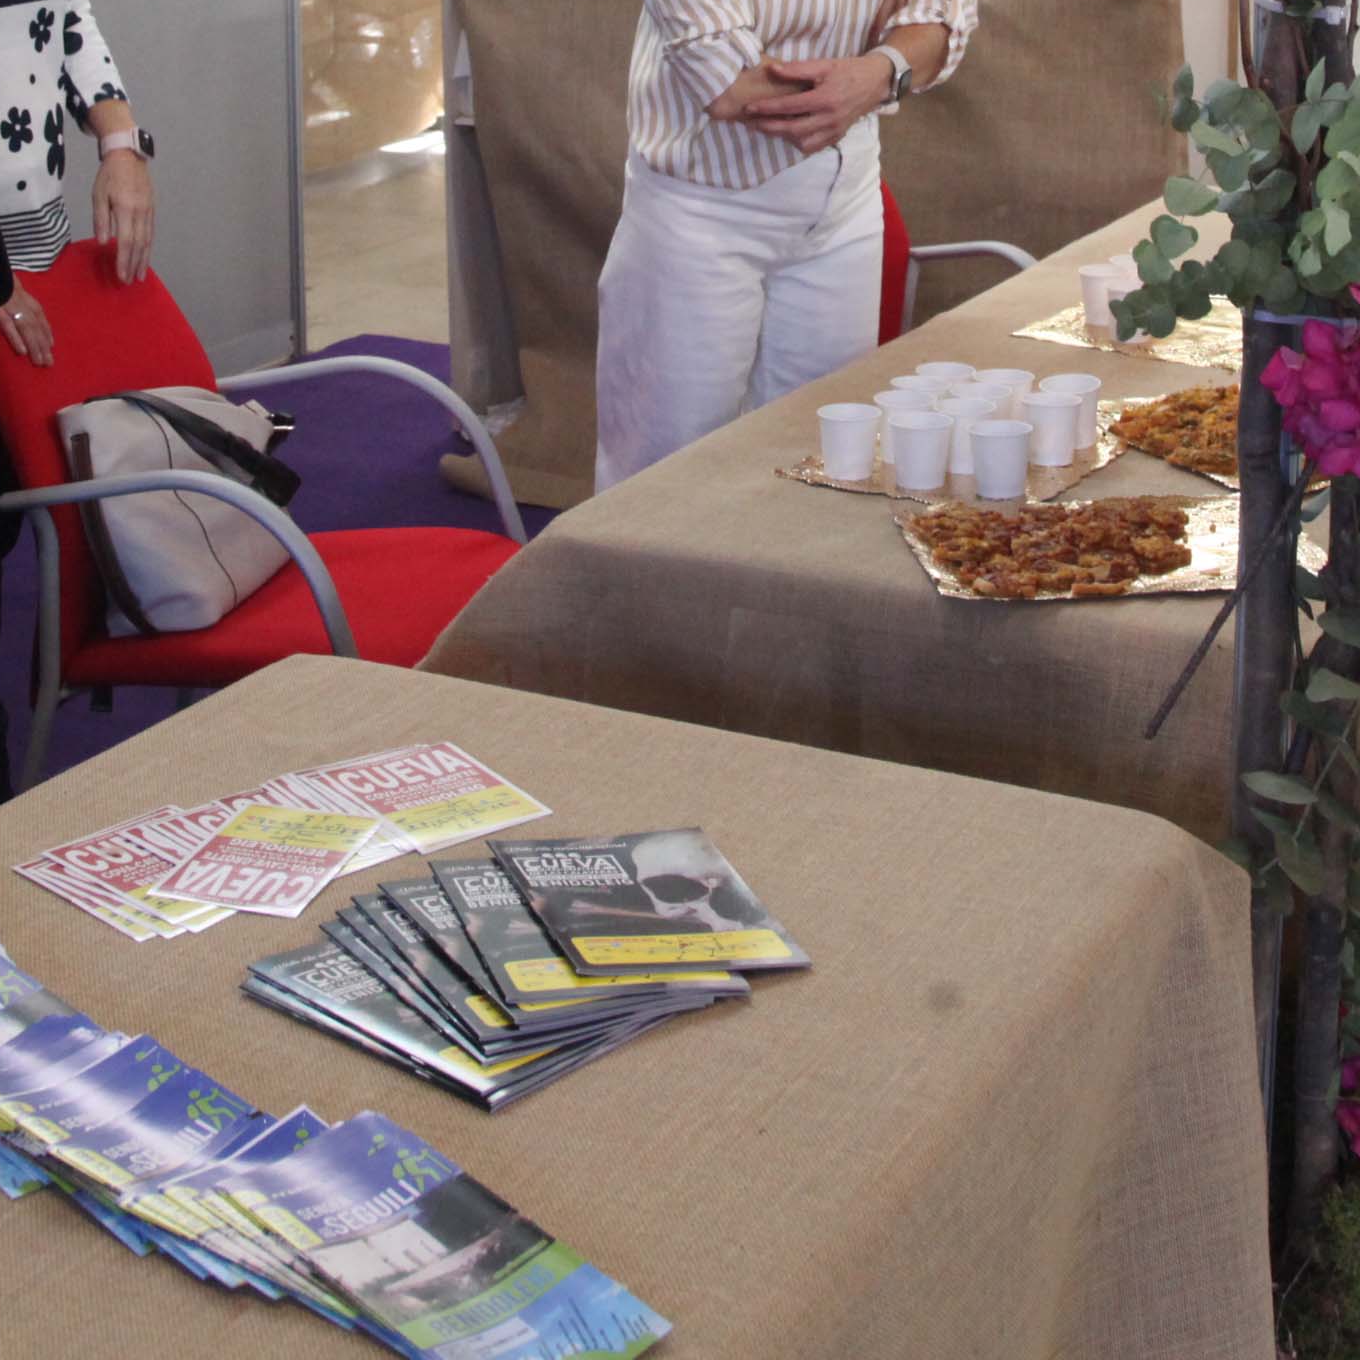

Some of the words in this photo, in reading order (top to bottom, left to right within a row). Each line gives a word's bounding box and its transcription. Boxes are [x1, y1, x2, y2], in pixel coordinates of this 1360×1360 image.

[338, 749, 473, 794] CUEVA
[231, 839, 329, 857] BENIDOLEIG
[523, 857, 616, 872] CUEVA
[175, 859, 314, 907] CUEVA
[322, 1179, 421, 1236] SEGUILI
